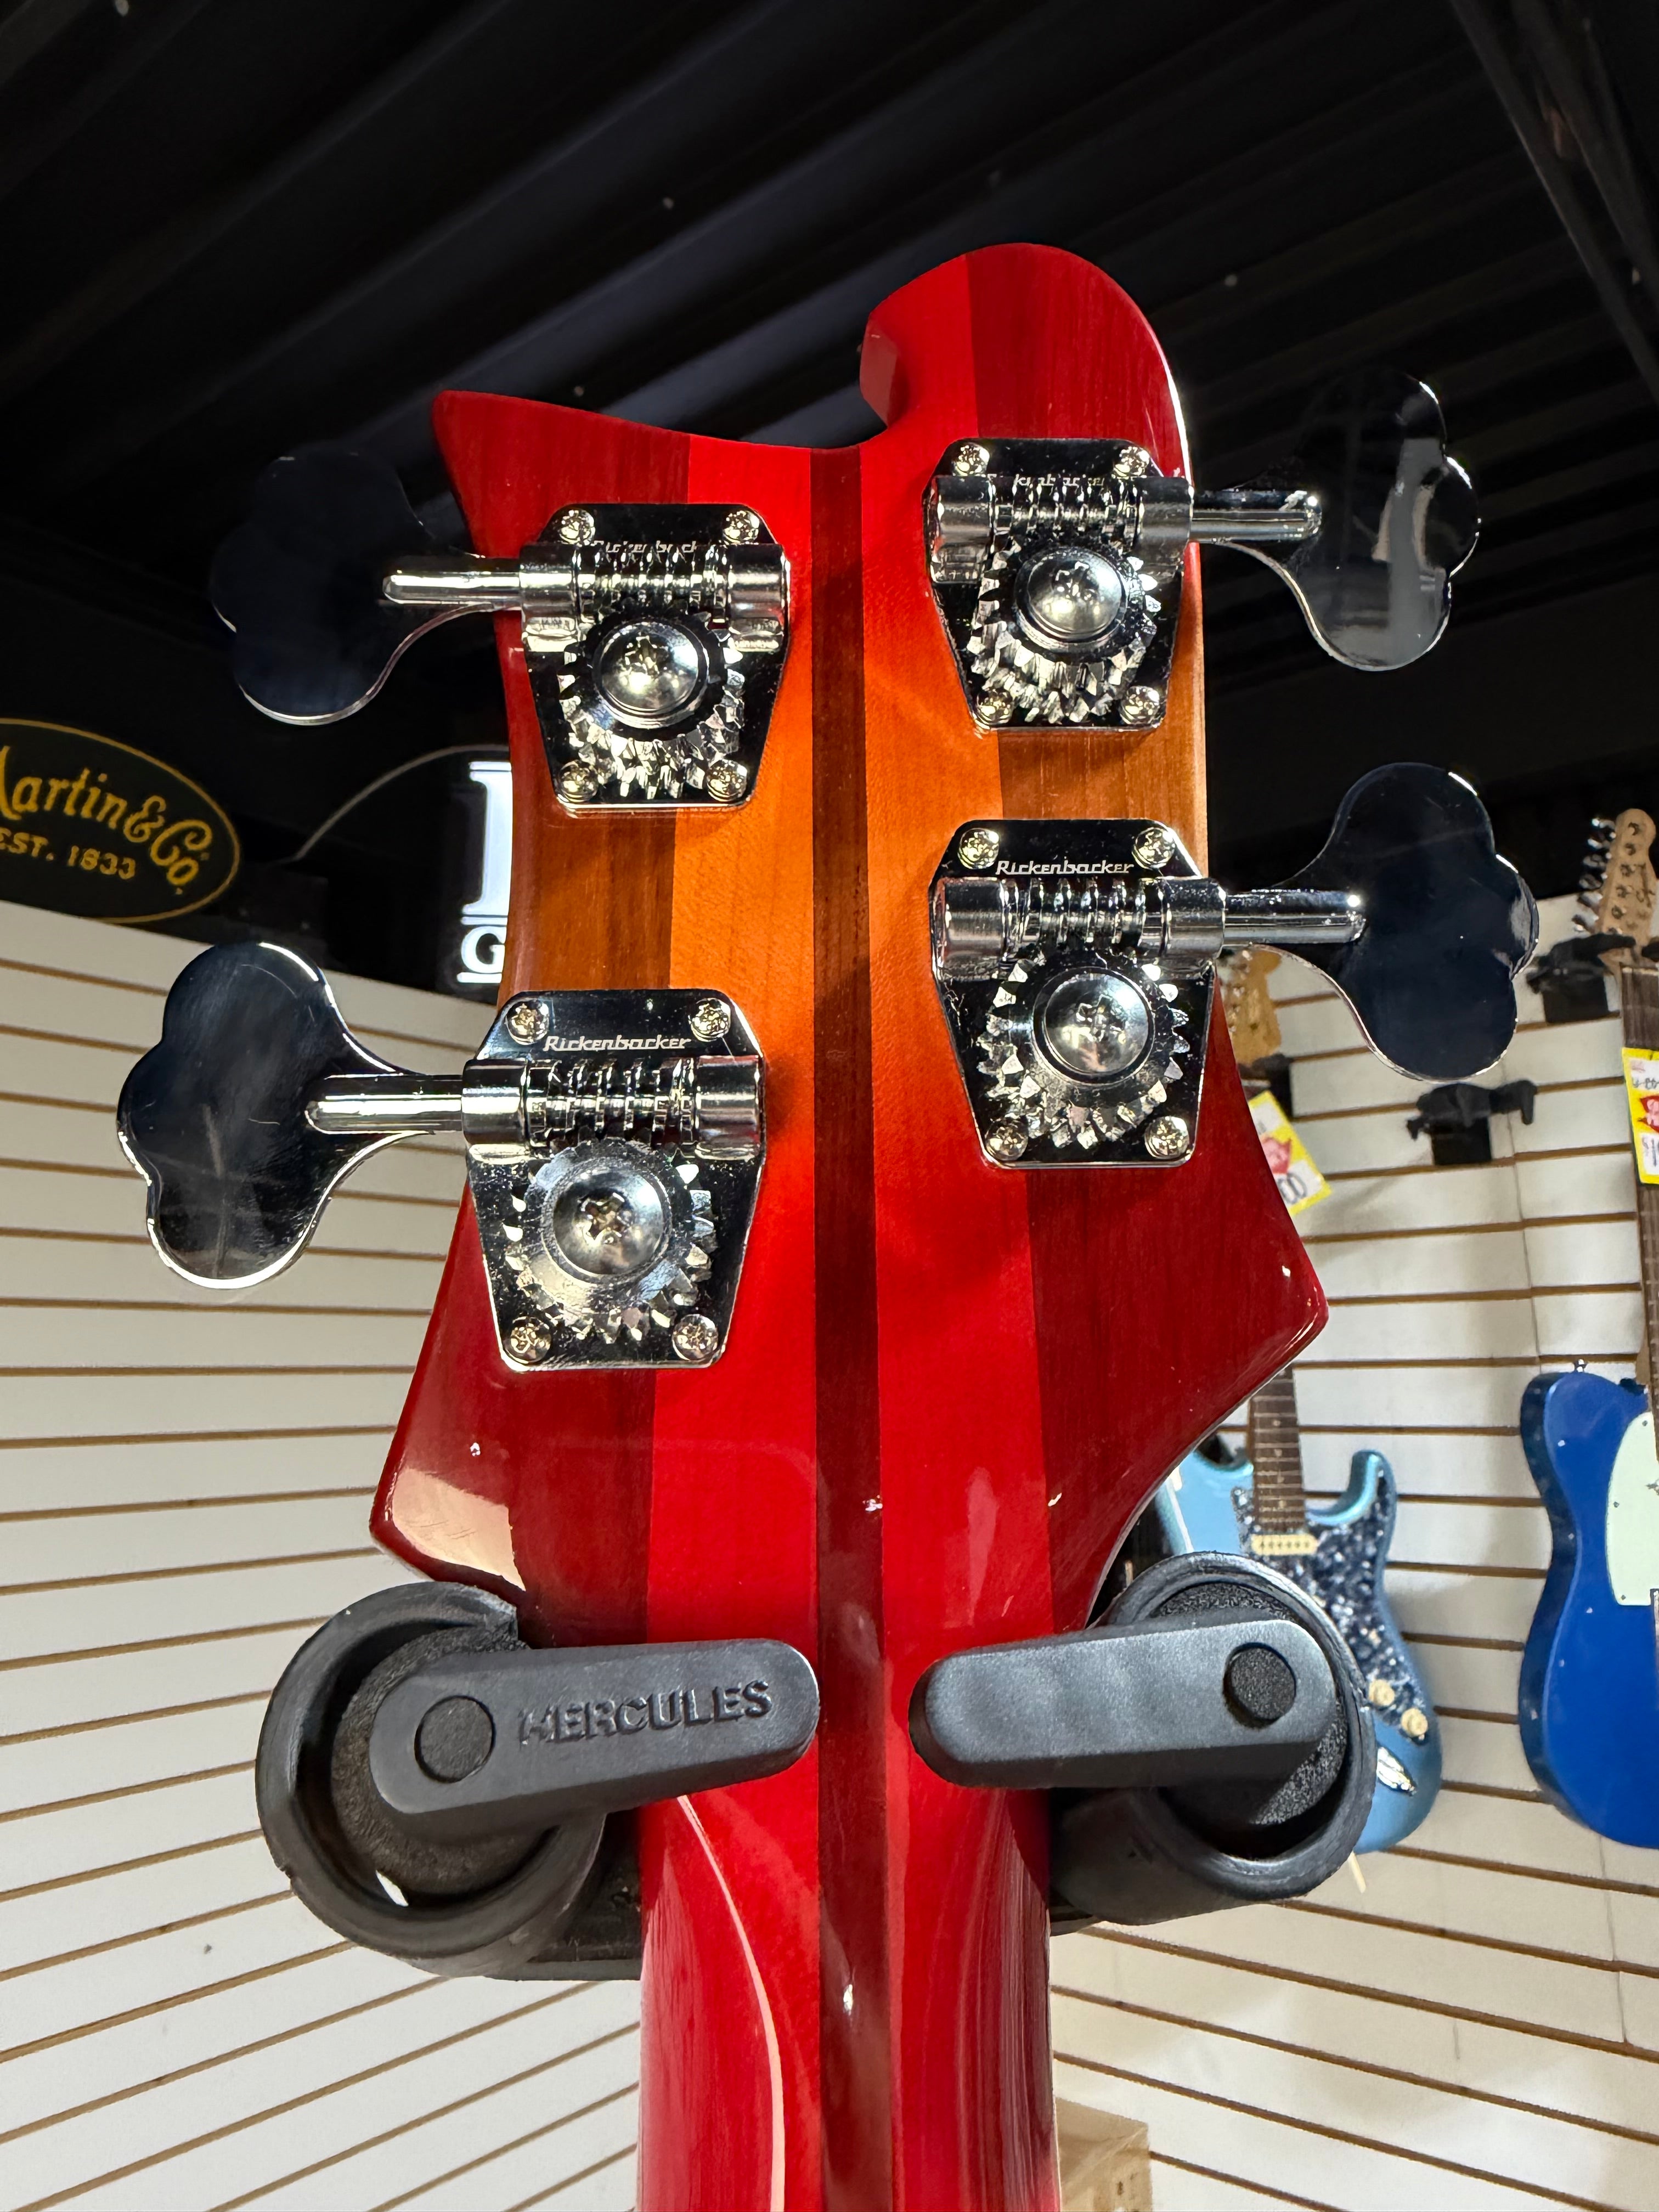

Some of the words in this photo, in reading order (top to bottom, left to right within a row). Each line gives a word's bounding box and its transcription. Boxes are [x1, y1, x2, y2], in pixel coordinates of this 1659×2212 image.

[67, 845, 136, 879] 1833
[995, 859, 1135, 876] Rickenbacker
[543, 1035, 691, 1052] Rickenbacker
[518, 1679, 772, 1745] HERCULES
